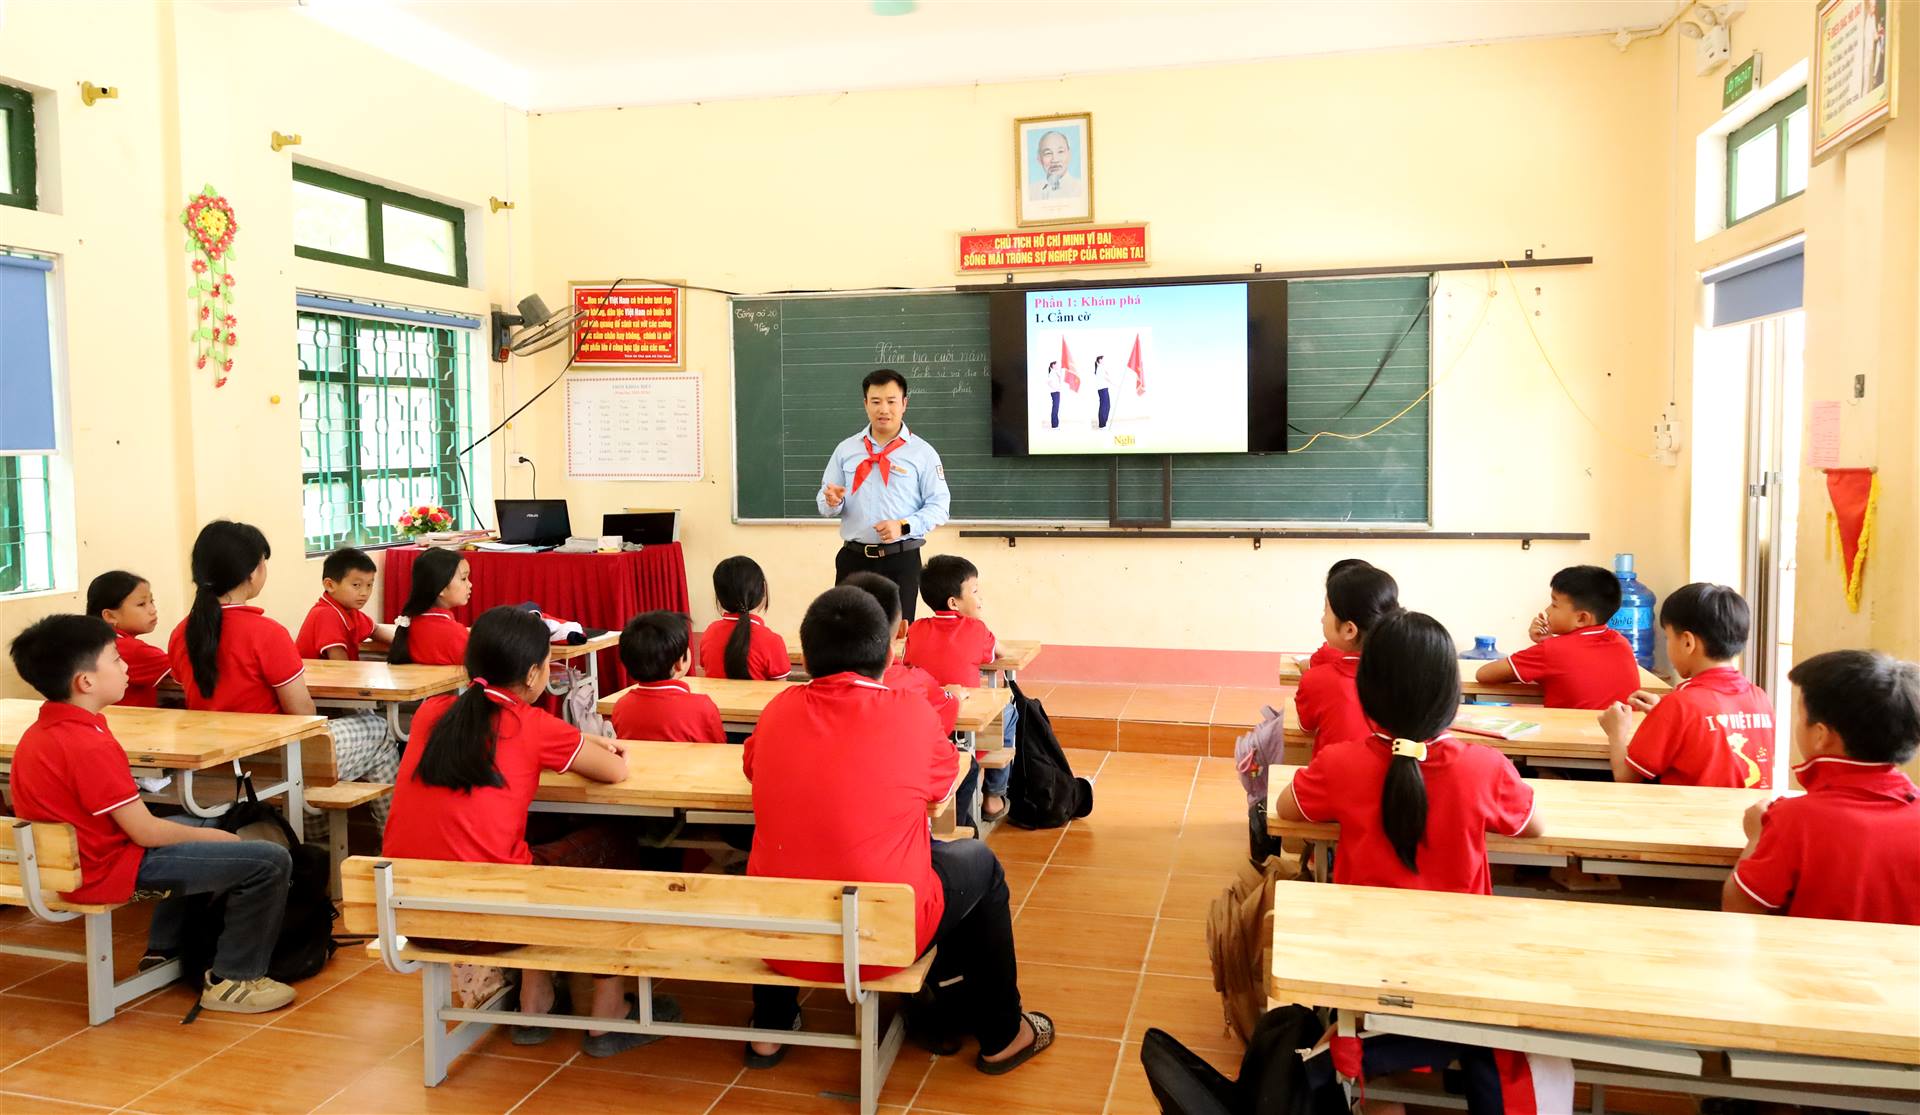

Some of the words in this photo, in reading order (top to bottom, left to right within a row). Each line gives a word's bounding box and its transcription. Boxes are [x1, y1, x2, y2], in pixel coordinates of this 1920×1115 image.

[995, 235, 1011, 249] CHỦ
[1034, 232, 1044, 248] HỒ
[1046, 232, 1061, 247] CHÍ
[1062, 233, 1084, 246] MINH
[1087, 231, 1096, 245] VĨ
[963, 251, 986, 266] SỐNG
[988, 251, 1004, 265] MÃI
[1006, 251, 1033, 265] TRONG
[1034, 250, 1047, 265] SỰ
[1048, 248, 1078, 264] NGHIỆP
[1080, 245, 1098, 261] CỦA
[1099, 244, 1128, 260] CHÚNG
[1130, 246, 1144, 259] TA!
[609, 296, 619, 305] Việt
[619, 296, 630, 304] Nam
[1034, 296, 1063, 309] Phần
[1067, 299, 1077, 308] 1:
[1081, 295, 1116, 307] Khám
[1120, 295, 1141, 309] phá
[624, 307, 634, 317] Việt
[634, 308, 646, 316] Nam
[1035, 313, 1044, 323] 1.
[1047, 309, 1074, 322] Cầm
[1077, 313, 1092, 322] cờ
[1705, 715, 1717, 731] I
